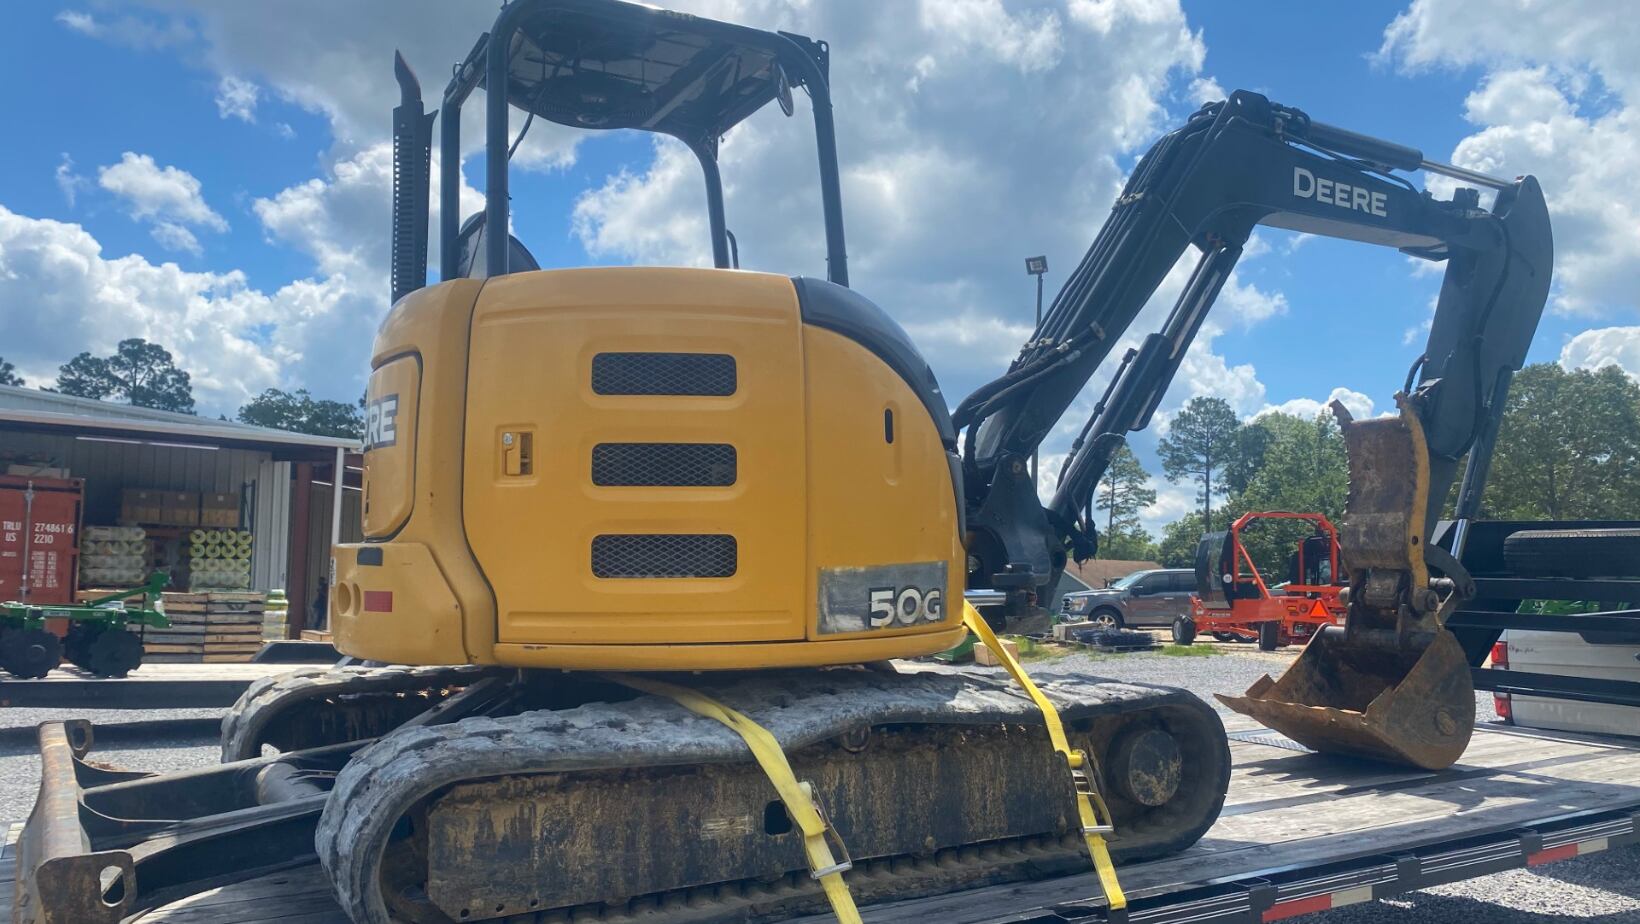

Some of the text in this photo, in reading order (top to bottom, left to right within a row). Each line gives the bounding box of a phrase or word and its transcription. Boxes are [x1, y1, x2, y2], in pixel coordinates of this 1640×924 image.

[1293, 166, 1388, 217] DEERE
[364, 399, 397, 448] RE
[2, 520, 22, 531] TRLU
[5, 532, 54, 544] US 2210
[869, 586, 941, 628] 50G
